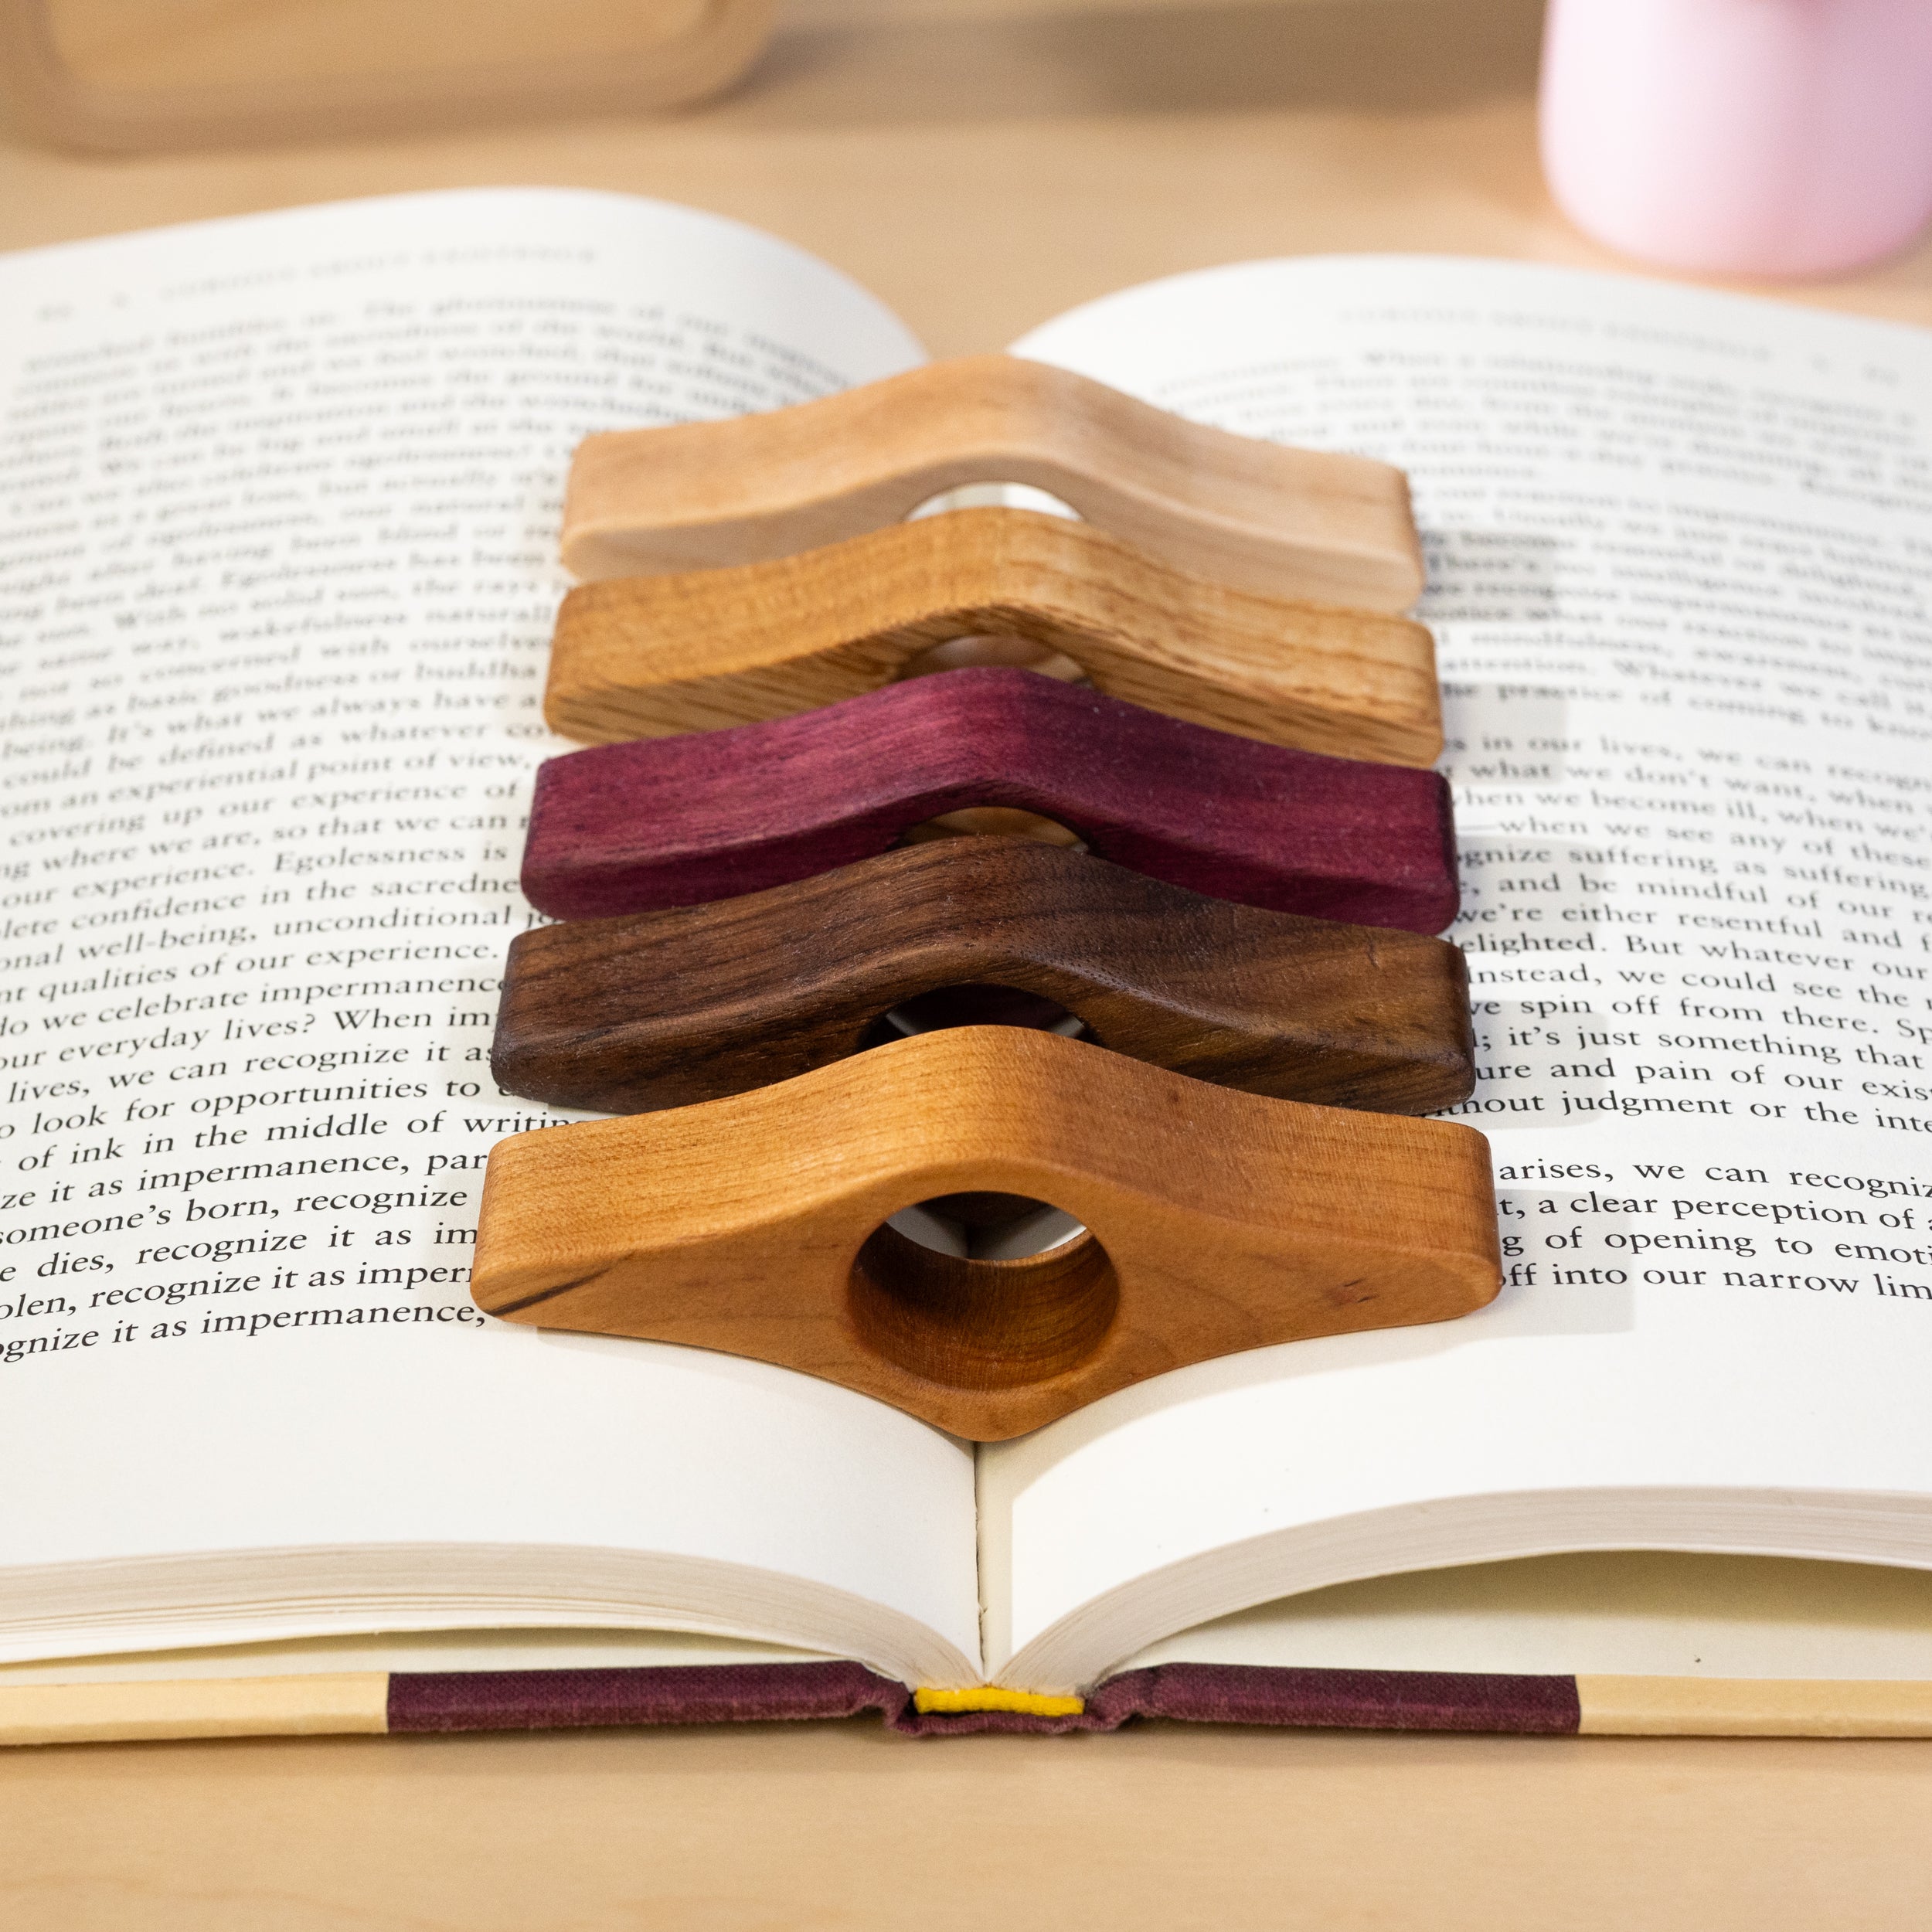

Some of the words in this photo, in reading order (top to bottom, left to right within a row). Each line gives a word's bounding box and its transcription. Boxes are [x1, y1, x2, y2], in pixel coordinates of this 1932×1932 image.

[212, 672, 359, 705] goodness
[369, 668, 402, 683] or
[415, 660, 537, 681] buddha
[167, 713, 243, 735] what
[257, 707, 298, 723] we
[311, 696, 420, 717] always
[434, 690, 509, 709] have
[2, 757, 92, 789] could
[107, 753, 142, 773] be
[158, 732, 275, 766] defined
[291, 735, 322, 749] as
[340, 723, 487, 743] whatever
[1482, 736, 1513, 751] in
[1528, 738, 1581, 753] our
[1599, 735, 1683, 762] lives,
[1698, 749, 1741, 764] we
[1756, 757, 1812, 774] can
[61, 791, 99, 809] an
[107, 753, 298, 803] experiential
[307, 757, 392, 783] point
[403, 752, 437, 769] of
[449, 753, 529, 769] view,
[1470, 760, 1551, 778] what
[1566, 767, 1610, 780] we
[1724, 778, 1816, 803] want,
[1828, 789, 1914, 815] when
[9, 815, 145, 847] covering
[163, 807, 203, 827] up
[219, 798, 274, 816] our
[291, 785, 467, 811] experience
[485, 781, 517, 798] of
[1536, 794, 1580, 806] we
[1590, 788, 1715, 815] become
[1726, 801, 1768, 824] ill,
[1777, 808, 1864, 833] when
[43, 847, 137, 871] where
[149, 839, 192, 855] we
[202, 832, 260, 850] are,
[274, 826, 308, 839] so
[318, 816, 382, 837] that
[395, 818, 439, 831] we
[450, 815, 507, 829] can
[1605, 824, 1649, 837] we
[1666, 828, 1713, 842] see
[1730, 833, 1786, 853] any
[1803, 838, 1833, 855] of
[1850, 842, 1930, 869] these
[72, 863, 253, 904] experience.
[274, 846, 465, 876] Egolessness
[483, 847, 507, 861] is
[1499, 872, 1560, 892] and
[1579, 872, 1615, 892] be
[1638, 881, 1767, 903] mindful
[1787, 892, 1818, 909] of
[1838, 901, 1891, 918] our
[1568, 847, 1718, 874] suffering
[1735, 862, 1767, 876] as
[1784, 855, 1930, 900] suffering
[70, 884, 246, 930] confidence
[261, 889, 290, 905] in
[306, 879, 355, 901] the
[1561, 903, 1655, 923] either
[1678, 914, 1822, 938] resentful
[1843, 930, 1902, 948] and
[78, 927, 257, 960] well-being,
[274, 904, 512, 936] unconditional
[39, 968, 180, 1007] qualities
[190, 957, 223, 977] of
[236, 954, 294, 971] our
[306, 946, 497, 968] experience.
[1626, 935, 1680, 954] But
[1700, 940, 1853, 971] whatever
[1872, 963, 1927, 980] our
[43, 1013, 87, 1030] we
[97, 992, 248, 1023] celebrate
[1618, 971, 1665, 985] we
[1682, 971, 1776, 992] could
[1793, 982, 1841, 998] see
[1858, 985, 1907, 1006] the
[59, 1026, 209, 1062] everyday
[224, 1013, 315, 1040] lives?
[334, 1008, 431, 1030] When
[1520, 993, 1592, 1020] spin
[1612, 997, 1657, 1015] off
[1680, 998, 1763, 1022] from
[1782, 1005, 1878, 1033] there.
[1578, 1026, 1638, 1049] just
[1658, 1033, 1842, 1063] something
[1855, 1044, 1922, 1069] that
[9, 1081, 90, 1103] lives,
[109, 1071, 154, 1088] we
[169, 1062, 226, 1081] can
[245, 1043, 409, 1073] recognize
[427, 1042, 449, 1061] it
[1551, 1057, 1615, 1077] and
[1635, 1061, 1711, 1083] pain
[1730, 1064, 1764, 1084] of
[1784, 1074, 1842, 1090] our
[32, 1104, 105, 1134] look
[126, 1099, 175, 1121] for
[191, 1077, 427, 1117] opportunities
[447, 1081, 481, 1097] to
[1563, 1090, 1731, 1116] judgment
[1750, 1104, 1786, 1117] or
[1804, 1101, 1858, 1124] the
[18, 1145, 57, 1171] of
[72, 1138, 122, 1164] ink
[145, 1134, 173, 1154] in
[196, 1124, 247, 1148] the
[267, 1113, 387, 1141] middle
[407, 1110, 447, 1133] of
[51, 1181, 74, 1202] it
[88, 1180, 122, 1198] as
[138, 1156, 409, 1192] impermanence,
[1500, 1158, 1614, 1182] arises,
[1634, 1165, 1684, 1179] we
[1706, 1168, 1768, 1183] can
[0, 1204, 171, 1244] omeone's
[186, 1199, 279, 1221] born,
[295, 1185, 468, 1214] recognize
[1539, 1199, 1557, 1213] a
[1570, 1191, 1658, 1213] clear
[1672, 1200, 1866, 1224] perception
[1879, 1208, 1913, 1229] of
[37, 1252, 114, 1277] dies,
[137, 1230, 307, 1264] recognize
[329, 1225, 355, 1247] it
[375, 1230, 411, 1246] as
[1545, 1226, 1582, 1249] of
[1604, 1229, 1756, 1257] opening
[1775, 1237, 1813, 1254] to
[90, 1271, 260, 1308] recognize
[273, 1267, 298, 1289] it
[308, 1270, 345, 1287] as
[1553, 1264, 1628, 1284] into
[1643, 1270, 1706, 1284] our
[1723, 1272, 1859, 1293] narrow
[113, 1320, 138, 1343] it
[151, 1321, 186, 1338] as
[202, 1306, 485, 1337] impermanence,
